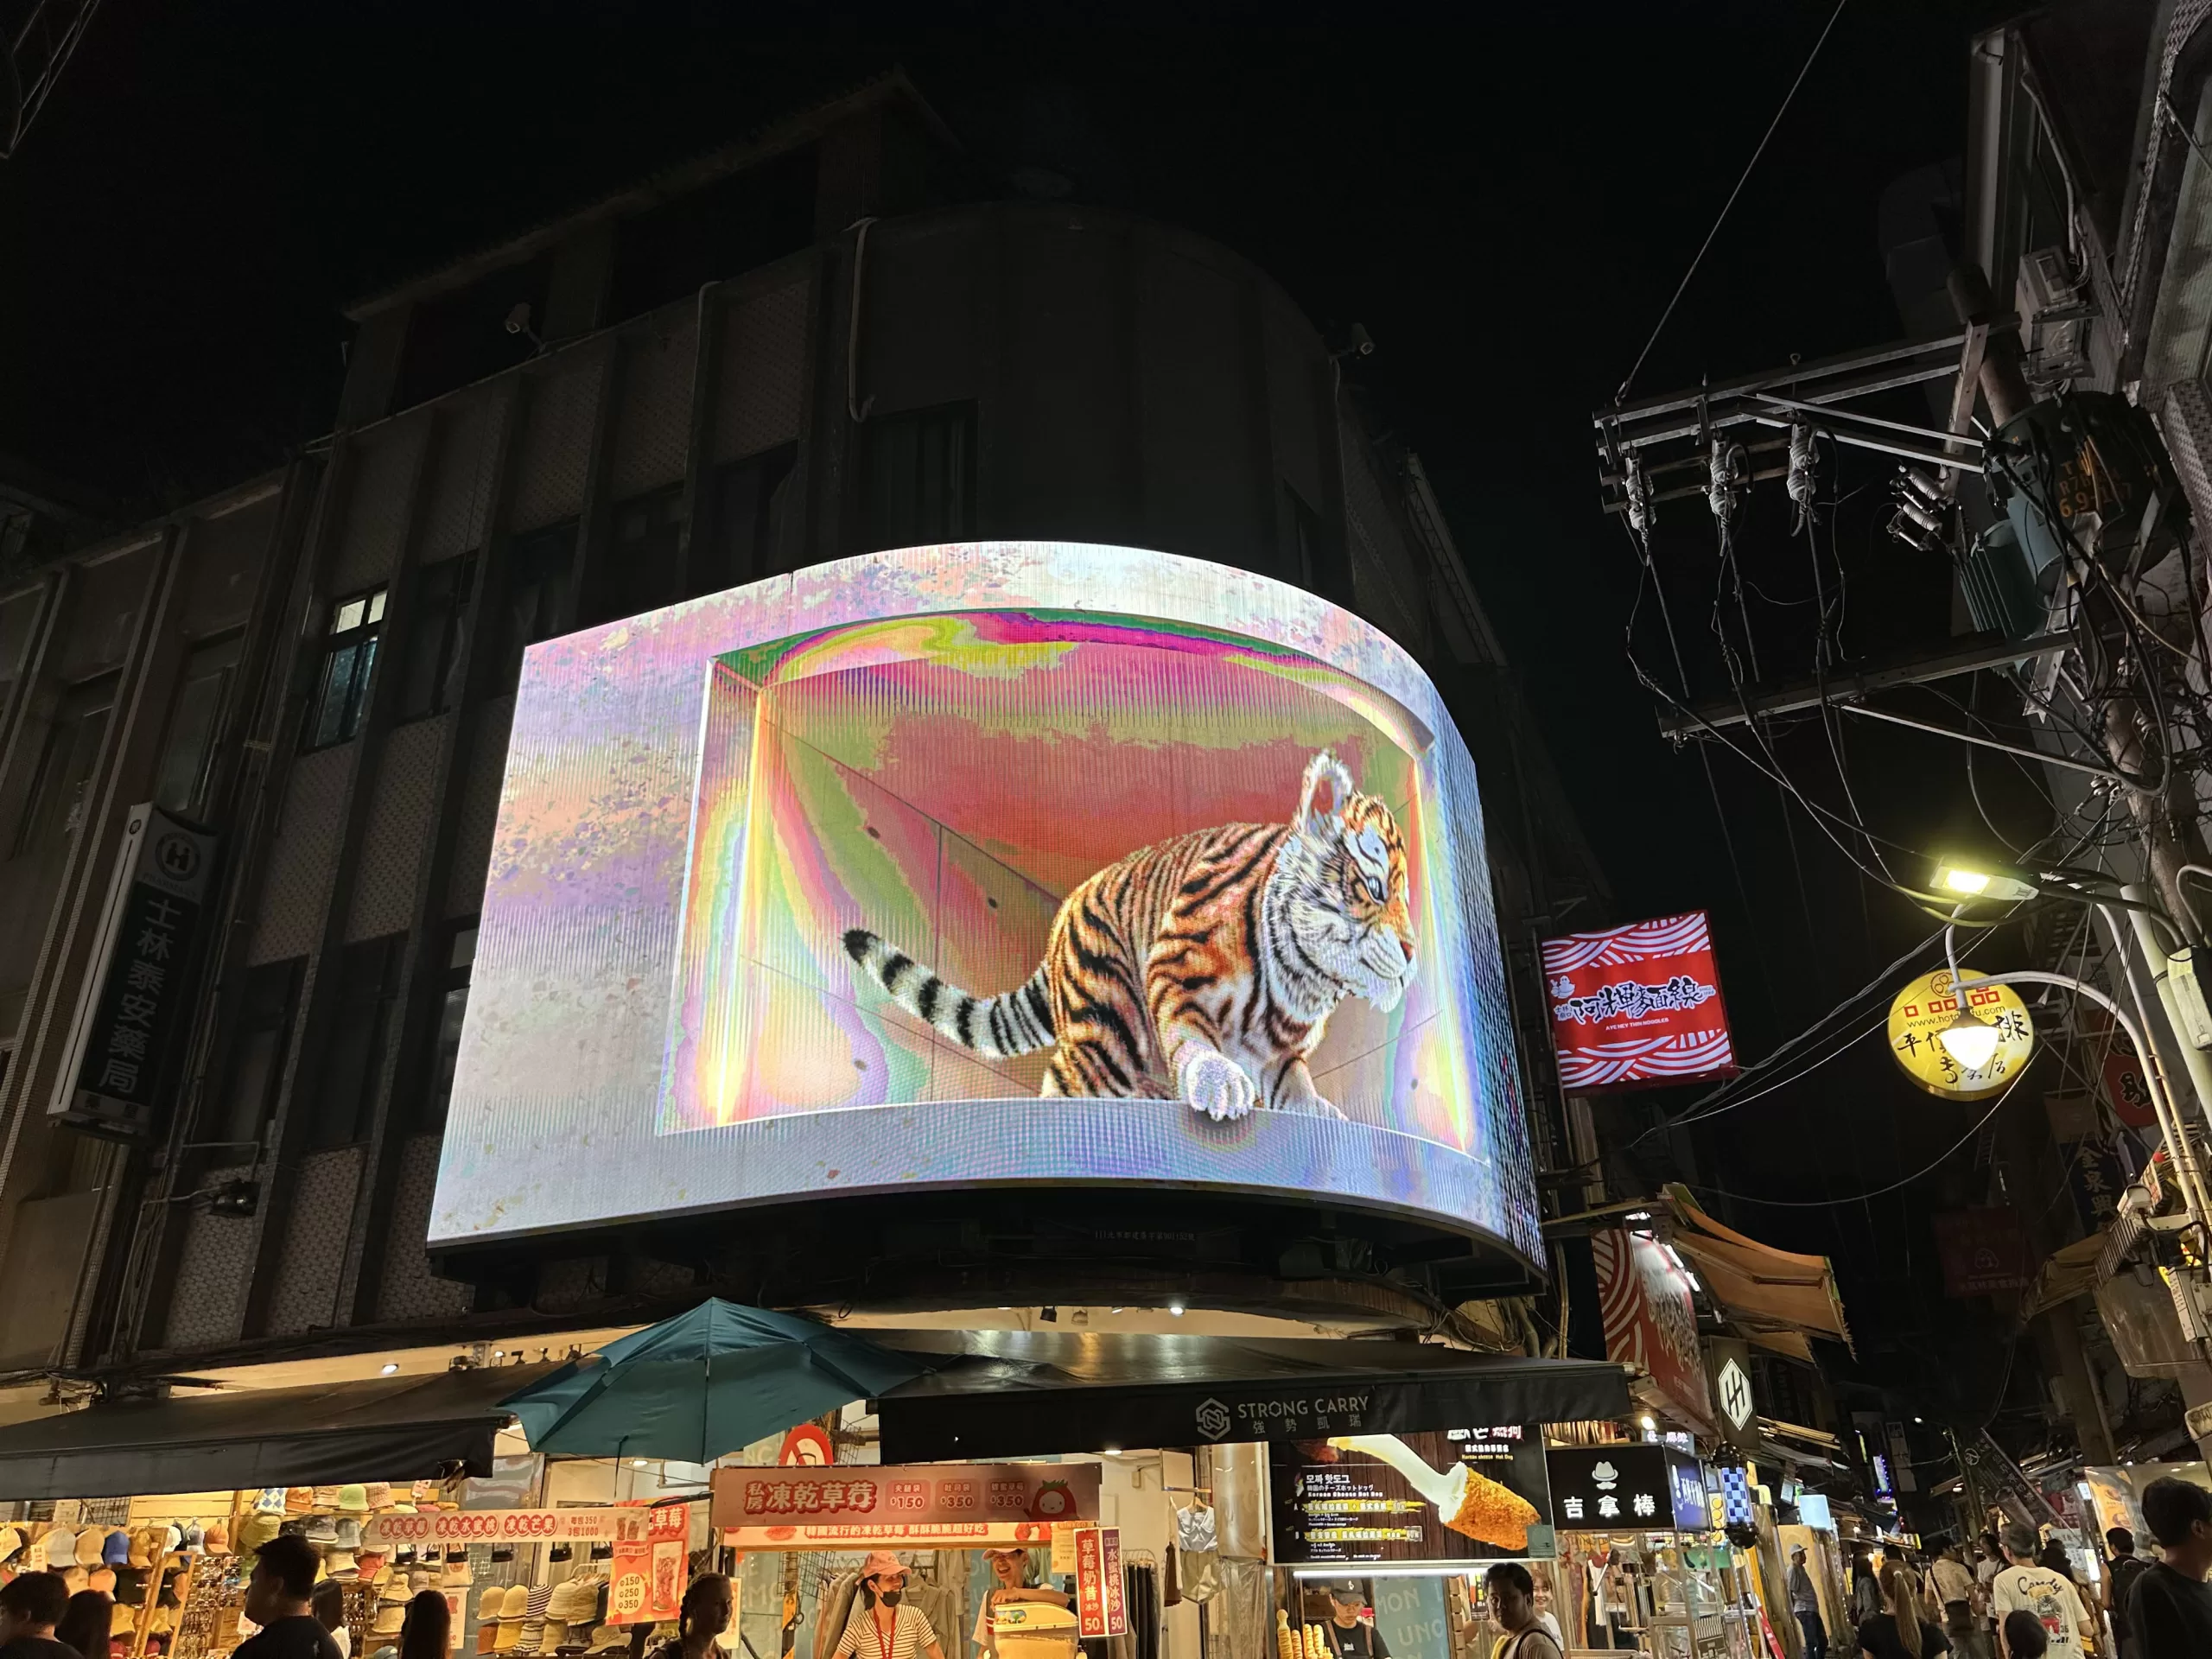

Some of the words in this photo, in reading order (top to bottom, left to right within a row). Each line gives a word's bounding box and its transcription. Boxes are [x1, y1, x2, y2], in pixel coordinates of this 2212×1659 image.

[99, 899, 182, 1095] 士林泰安藥局
[1570, 977, 1702, 1023] 阿輝麵線
[1237, 1401, 1308, 1418] STRONG
[1314, 1395, 1369, 1414] CARRY
[1254, 1414, 1362, 1434] 強勢凱瑞
[766, 1482, 874, 1510] 凍乾草莓
[891, 1497, 924, 1509] $150
[940, 1497, 974, 1508] $350
[1563, 1493, 1656, 1519] 吉拿棒
[435, 1516, 497, 1535] 凍乾水蜜桃
[505, 1515, 556, 1535] 凍乾芒果
[1081, 1538, 1097, 1601] 草莓奶昔
[1107, 1548, 1122, 1612] 水蜜桃冰沙
[1084, 1617, 1101, 1631] 50
[1110, 1616, 1123, 1630] 50
